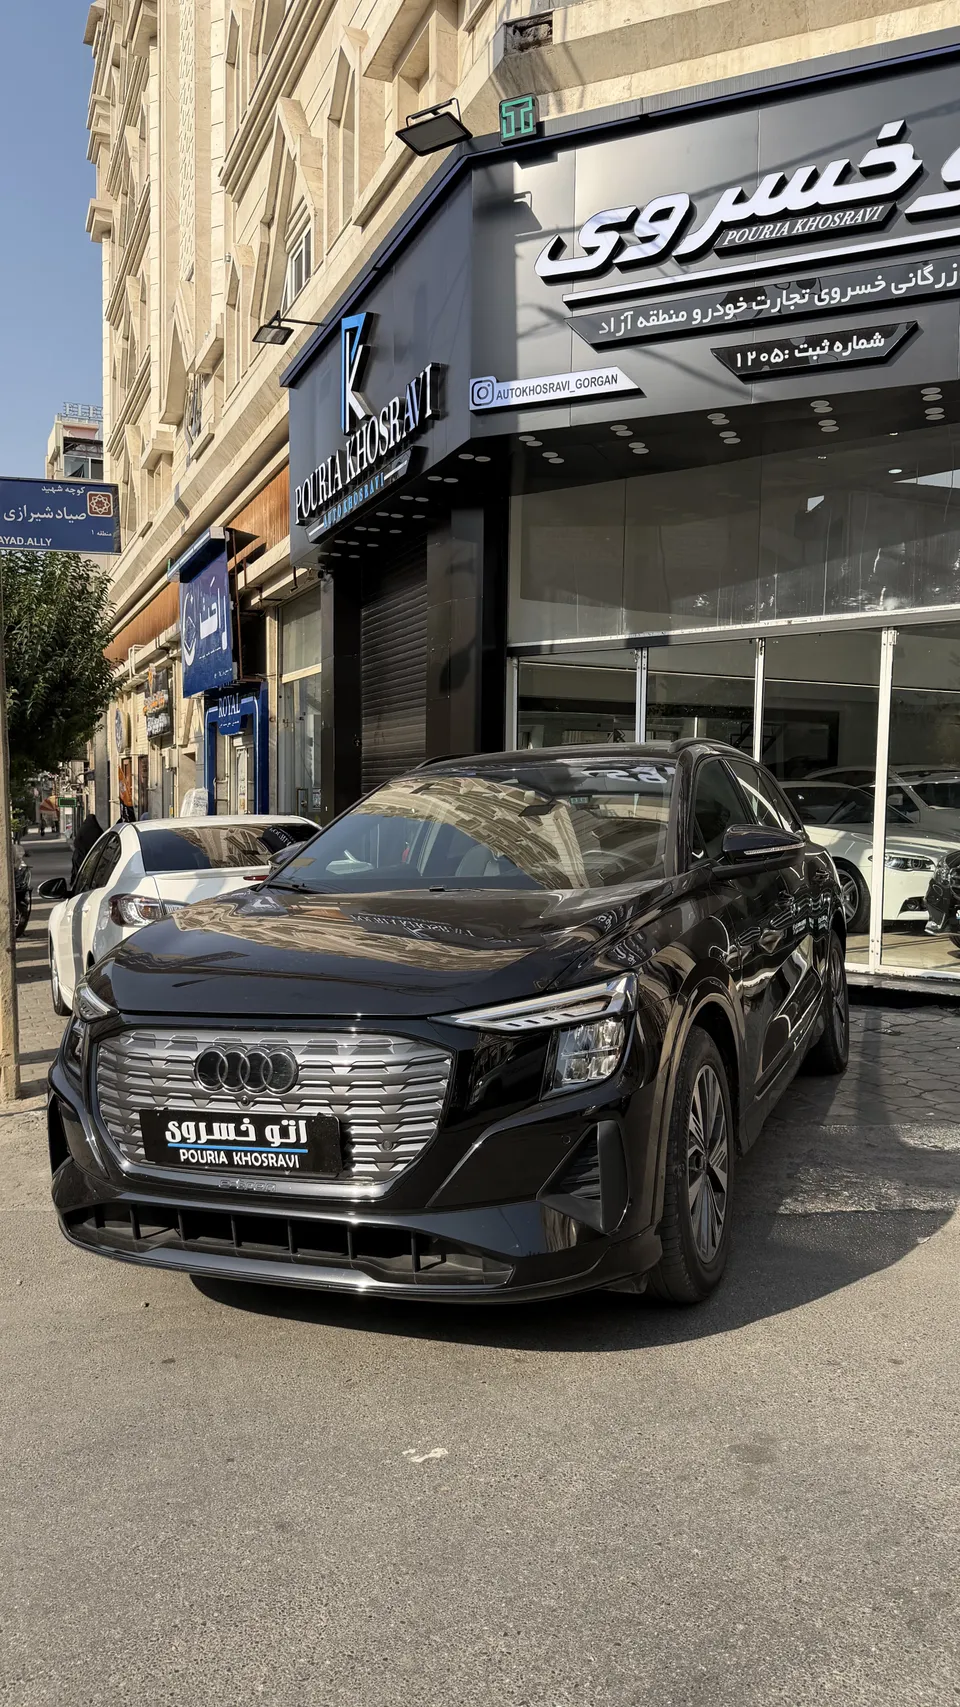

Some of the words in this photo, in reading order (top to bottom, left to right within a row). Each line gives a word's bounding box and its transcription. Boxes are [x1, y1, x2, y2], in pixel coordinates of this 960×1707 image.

[534, 119, 923, 280] خسروی
[722, 221, 789, 246] POURIA
[791, 205, 885, 235] KHOSRAVI
[752, 288, 811, 314] تجارت
[814, 275, 886, 306] خسروی
[637, 309, 688, 329] منطقه
[691, 296, 748, 325] خودرو
[598, 311, 634, 337] آزاد
[794, 338, 830, 361] ثبت
[841, 332, 885, 357] شماره
[495, 373, 618, 401] AUTOKHOSRAVI_GORGAN
[295, 449, 343, 526] POURIA
[345, 362, 433, 485] KHOSRAVI
[41, 484, 63, 495] شهید
[64, 486, 86, 497] کوچه
[3, 504, 54, 523] شیرازی
[55, 506, 87, 524] صیاد
[218, 692, 241, 718] ROYAL
[165, 1117, 257, 1144] خسروی
[264, 1119, 308, 1147] اتو
[179, 1148, 229, 1165] POURIA
[232, 1151, 300, 1169] KHOSRAVI
